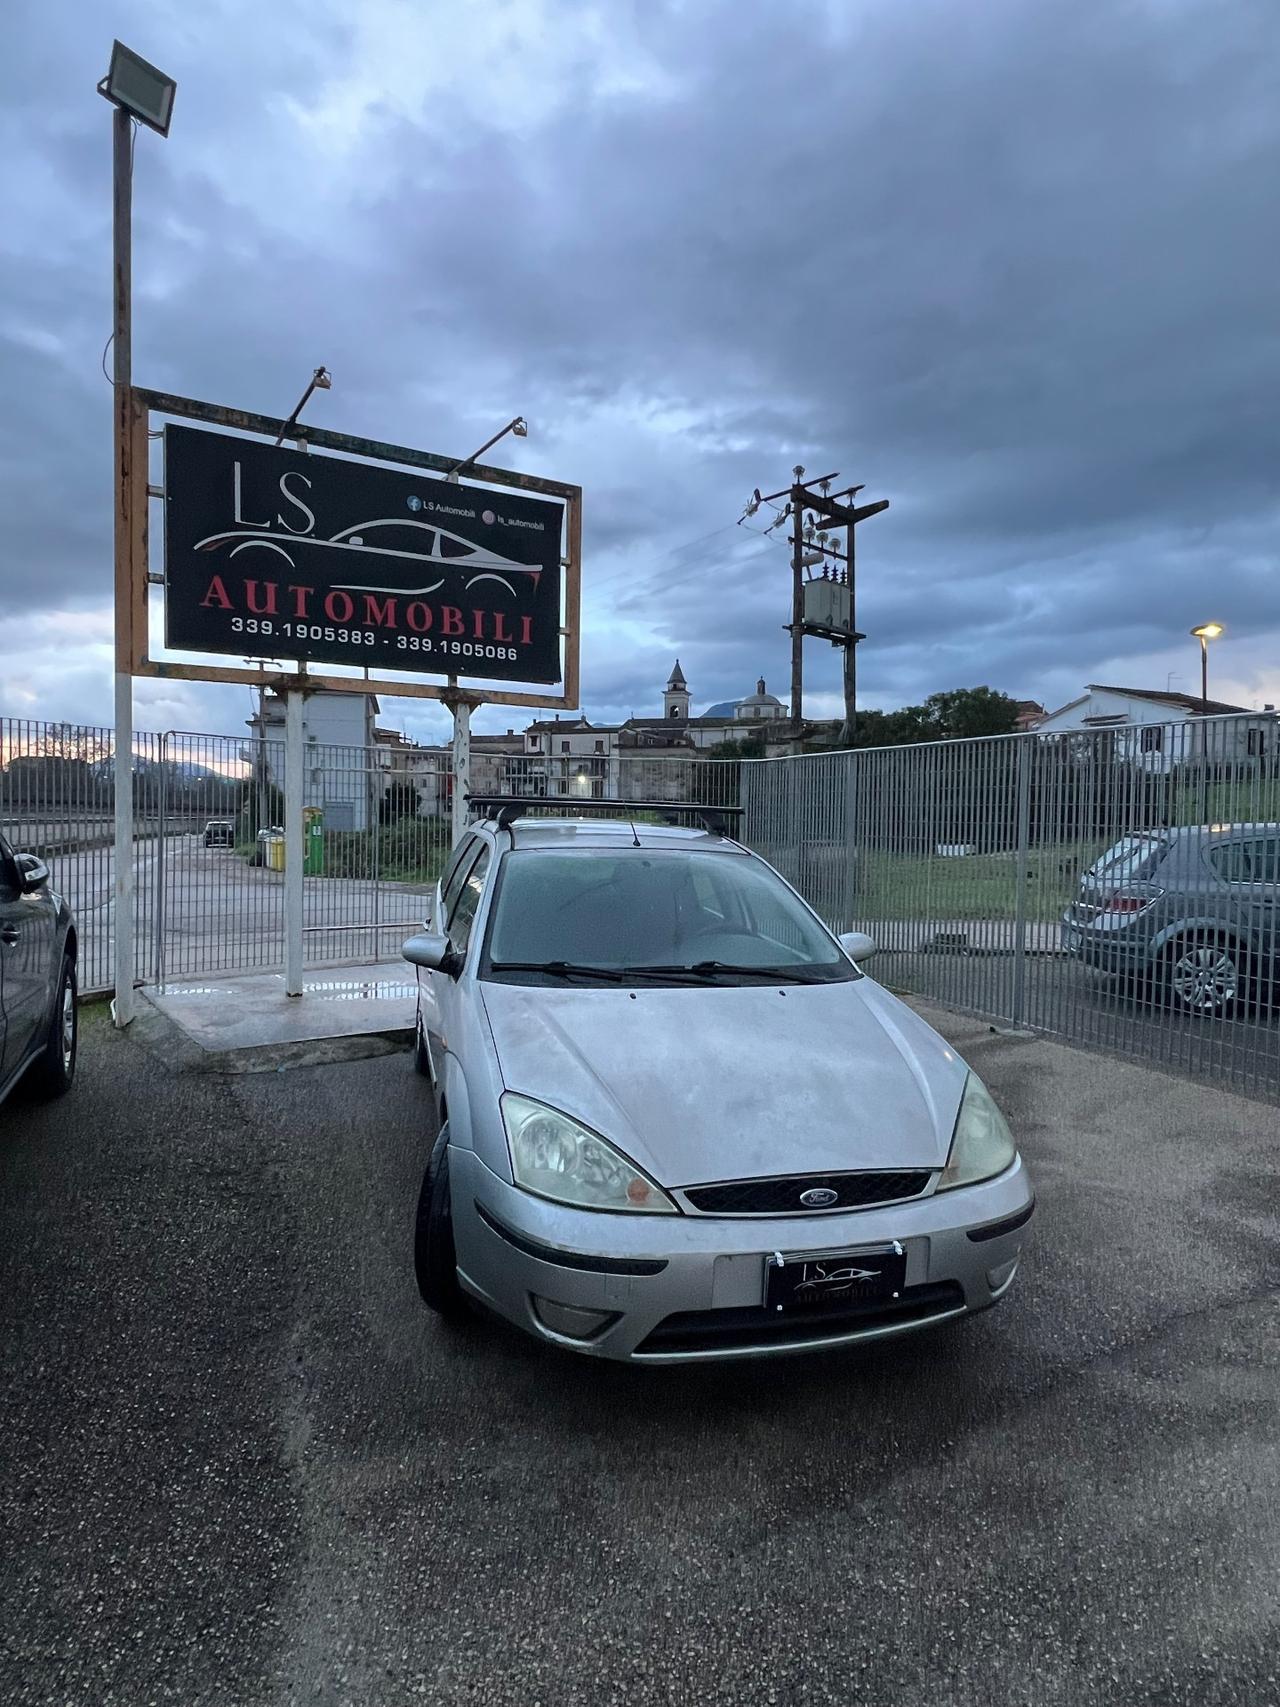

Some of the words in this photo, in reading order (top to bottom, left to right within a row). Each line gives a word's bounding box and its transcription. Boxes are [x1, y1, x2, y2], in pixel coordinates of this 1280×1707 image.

[234, 461, 315, 534] LS
[423, 500, 434, 511] LS
[435, 503, 475, 518] Automobili
[199, 575, 533, 644] AUTOMOBILI
[231, 617, 375, 646] 339.1905383
[397, 635, 518, 661] 339.1905086
